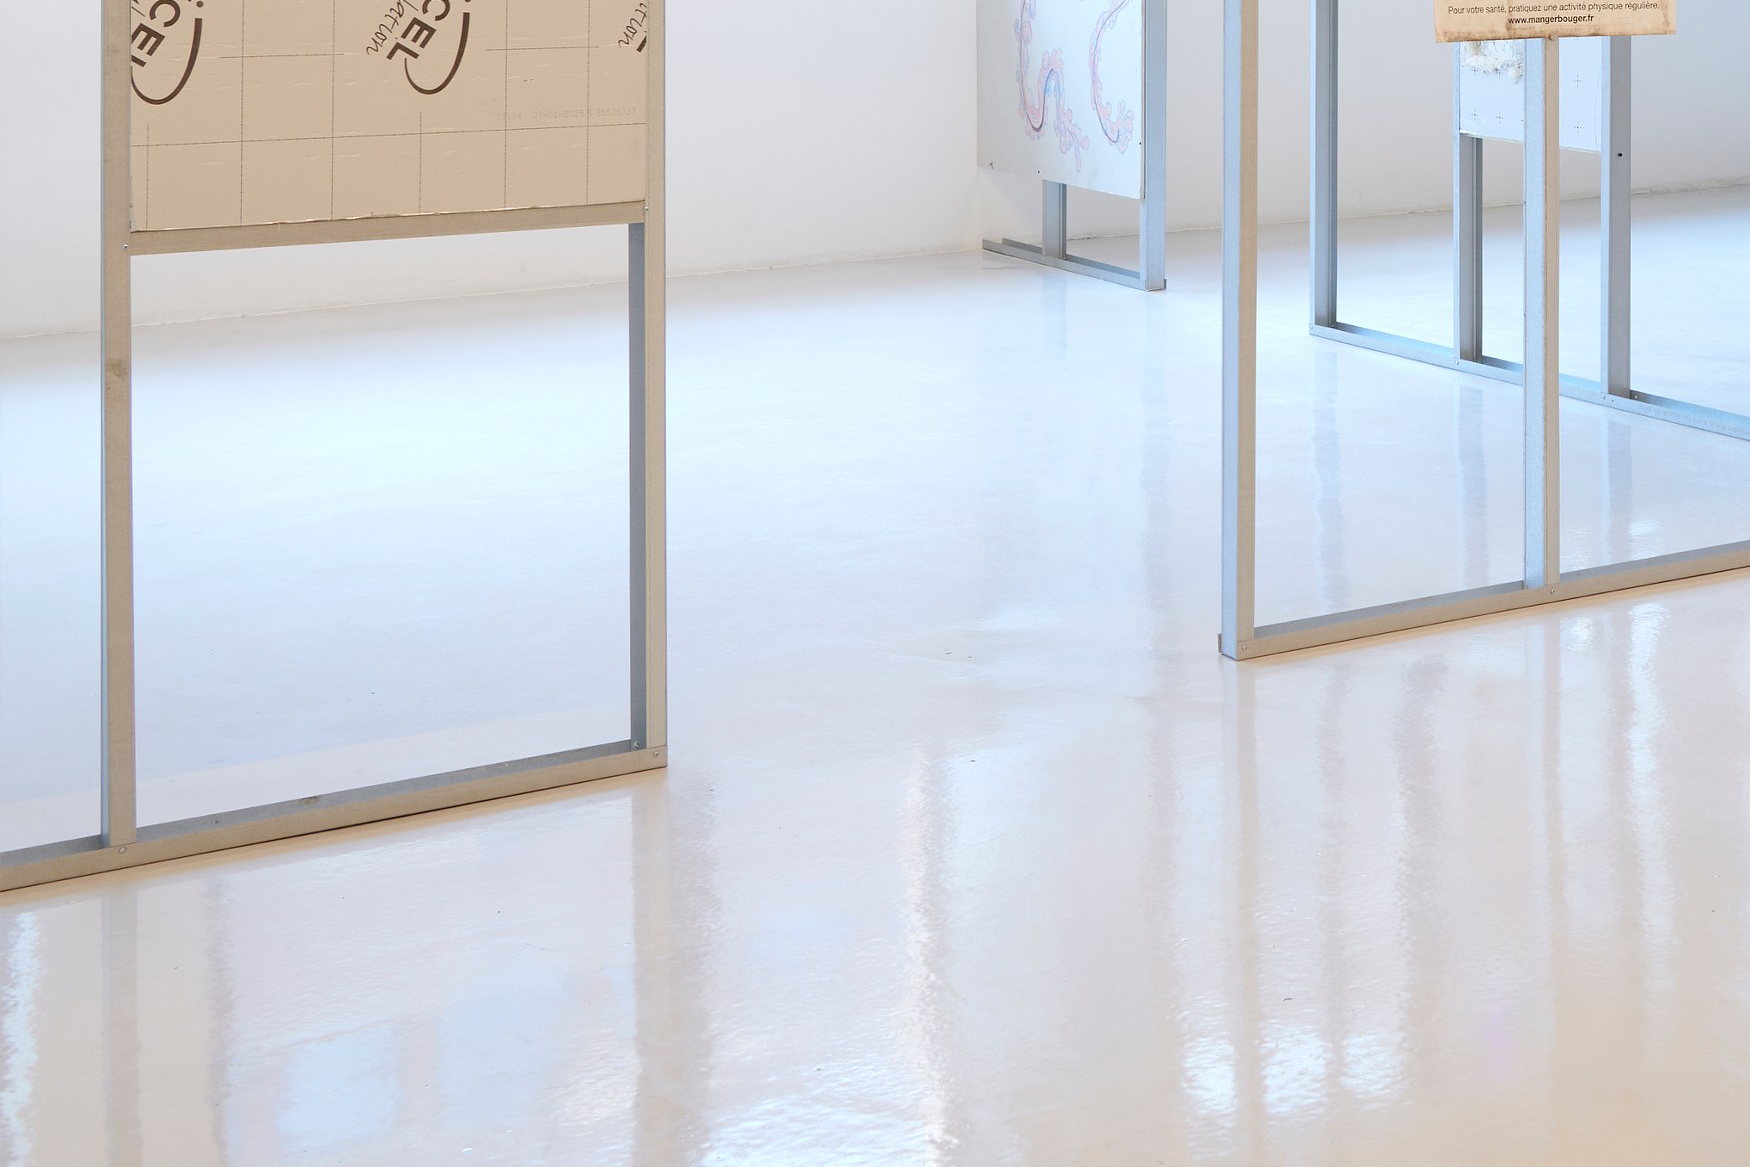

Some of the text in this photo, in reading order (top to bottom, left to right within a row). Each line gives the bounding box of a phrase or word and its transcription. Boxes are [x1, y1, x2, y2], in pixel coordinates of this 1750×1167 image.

[1448, 5, 1465, 14] Pour
[1466, 5, 1484, 14] votre
[1485, 5, 1507, 14] santé,
[1508, 4, 1542, 14] pratiquez
[1559, 3, 1586, 12] activité
[1588, 3, 1623, 13] physique
[1624, 2, 1660, 12] régulière.
[1508, 15, 1595, 24] www.mangerbouger.fr
